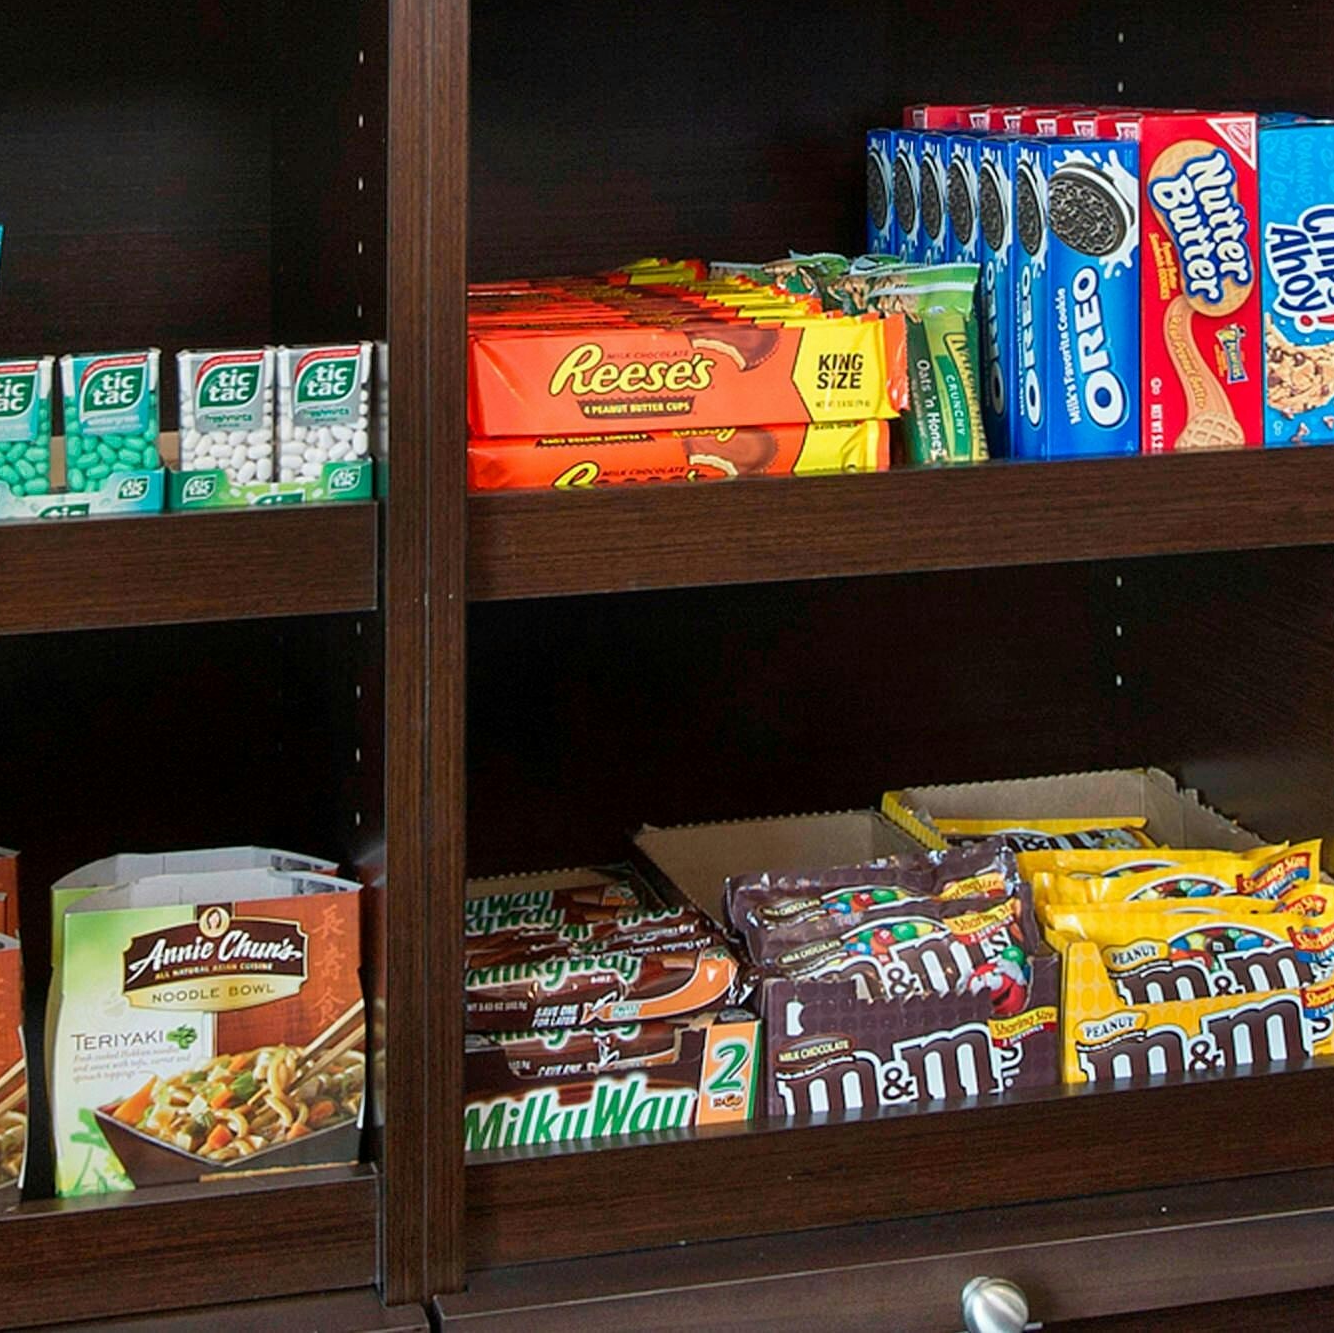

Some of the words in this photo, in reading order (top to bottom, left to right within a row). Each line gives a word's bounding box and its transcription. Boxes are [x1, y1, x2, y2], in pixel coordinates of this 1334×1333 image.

[1186, 151, 1252, 283] Nutter
[1152, 174, 1219, 302] Butter
[1054, 287, 1069, 331] Cookie
[1021, 265, 1042, 427] OREO
[1072, 266, 1124, 427] OREO
[818, 353, 865, 373] KING
[1058, 330, 1076, 384] Favorite
[218, 368, 252, 387] tic
[316, 364, 350, 381] tic
[549, 343, 717, 397] Reese's
[101, 372, 135, 390] tic
[306, 380, 349, 397] tac
[816, 372, 863, 391] SIZE
[92, 389, 134, 406] tac
[208, 386, 251, 402] tac
[582, 404, 591, 415] 4
[592, 404, 628, 415] PEANUT
[629, 402, 665, 414] BUTTER
[666, 400, 692, 413] CUPS
[945, 374, 966, 436] CRUNCHY
[1065, 385, 1082, 425] Milk's
[124, 935, 213, 985] Annie
[218, 930, 303, 962] Chun's
[1110, 945, 1159, 966] PEANUT
[155, 971, 172, 980] ALL
[173, 966, 210, 977] NATURAL
[240, 962, 274, 971] CUISINE
[152, 988, 221, 1004] NOODLE
[228, 983, 276, 997] BOWL
[532, 1017, 549, 1028] FOR
[549, 1016, 578, 1027] LATER
[535, 1005, 558, 1018] SAVE
[560, 1005, 579, 1017] ONE
[1084, 1016, 1135, 1038] PEANUT
[71, 1029, 165, 1051] TERIYAKI
[778, 1049, 801, 1062] MILK
[801, 1039, 850, 1061] CHOCOLATE
[708, 1043, 747, 1091] 2
